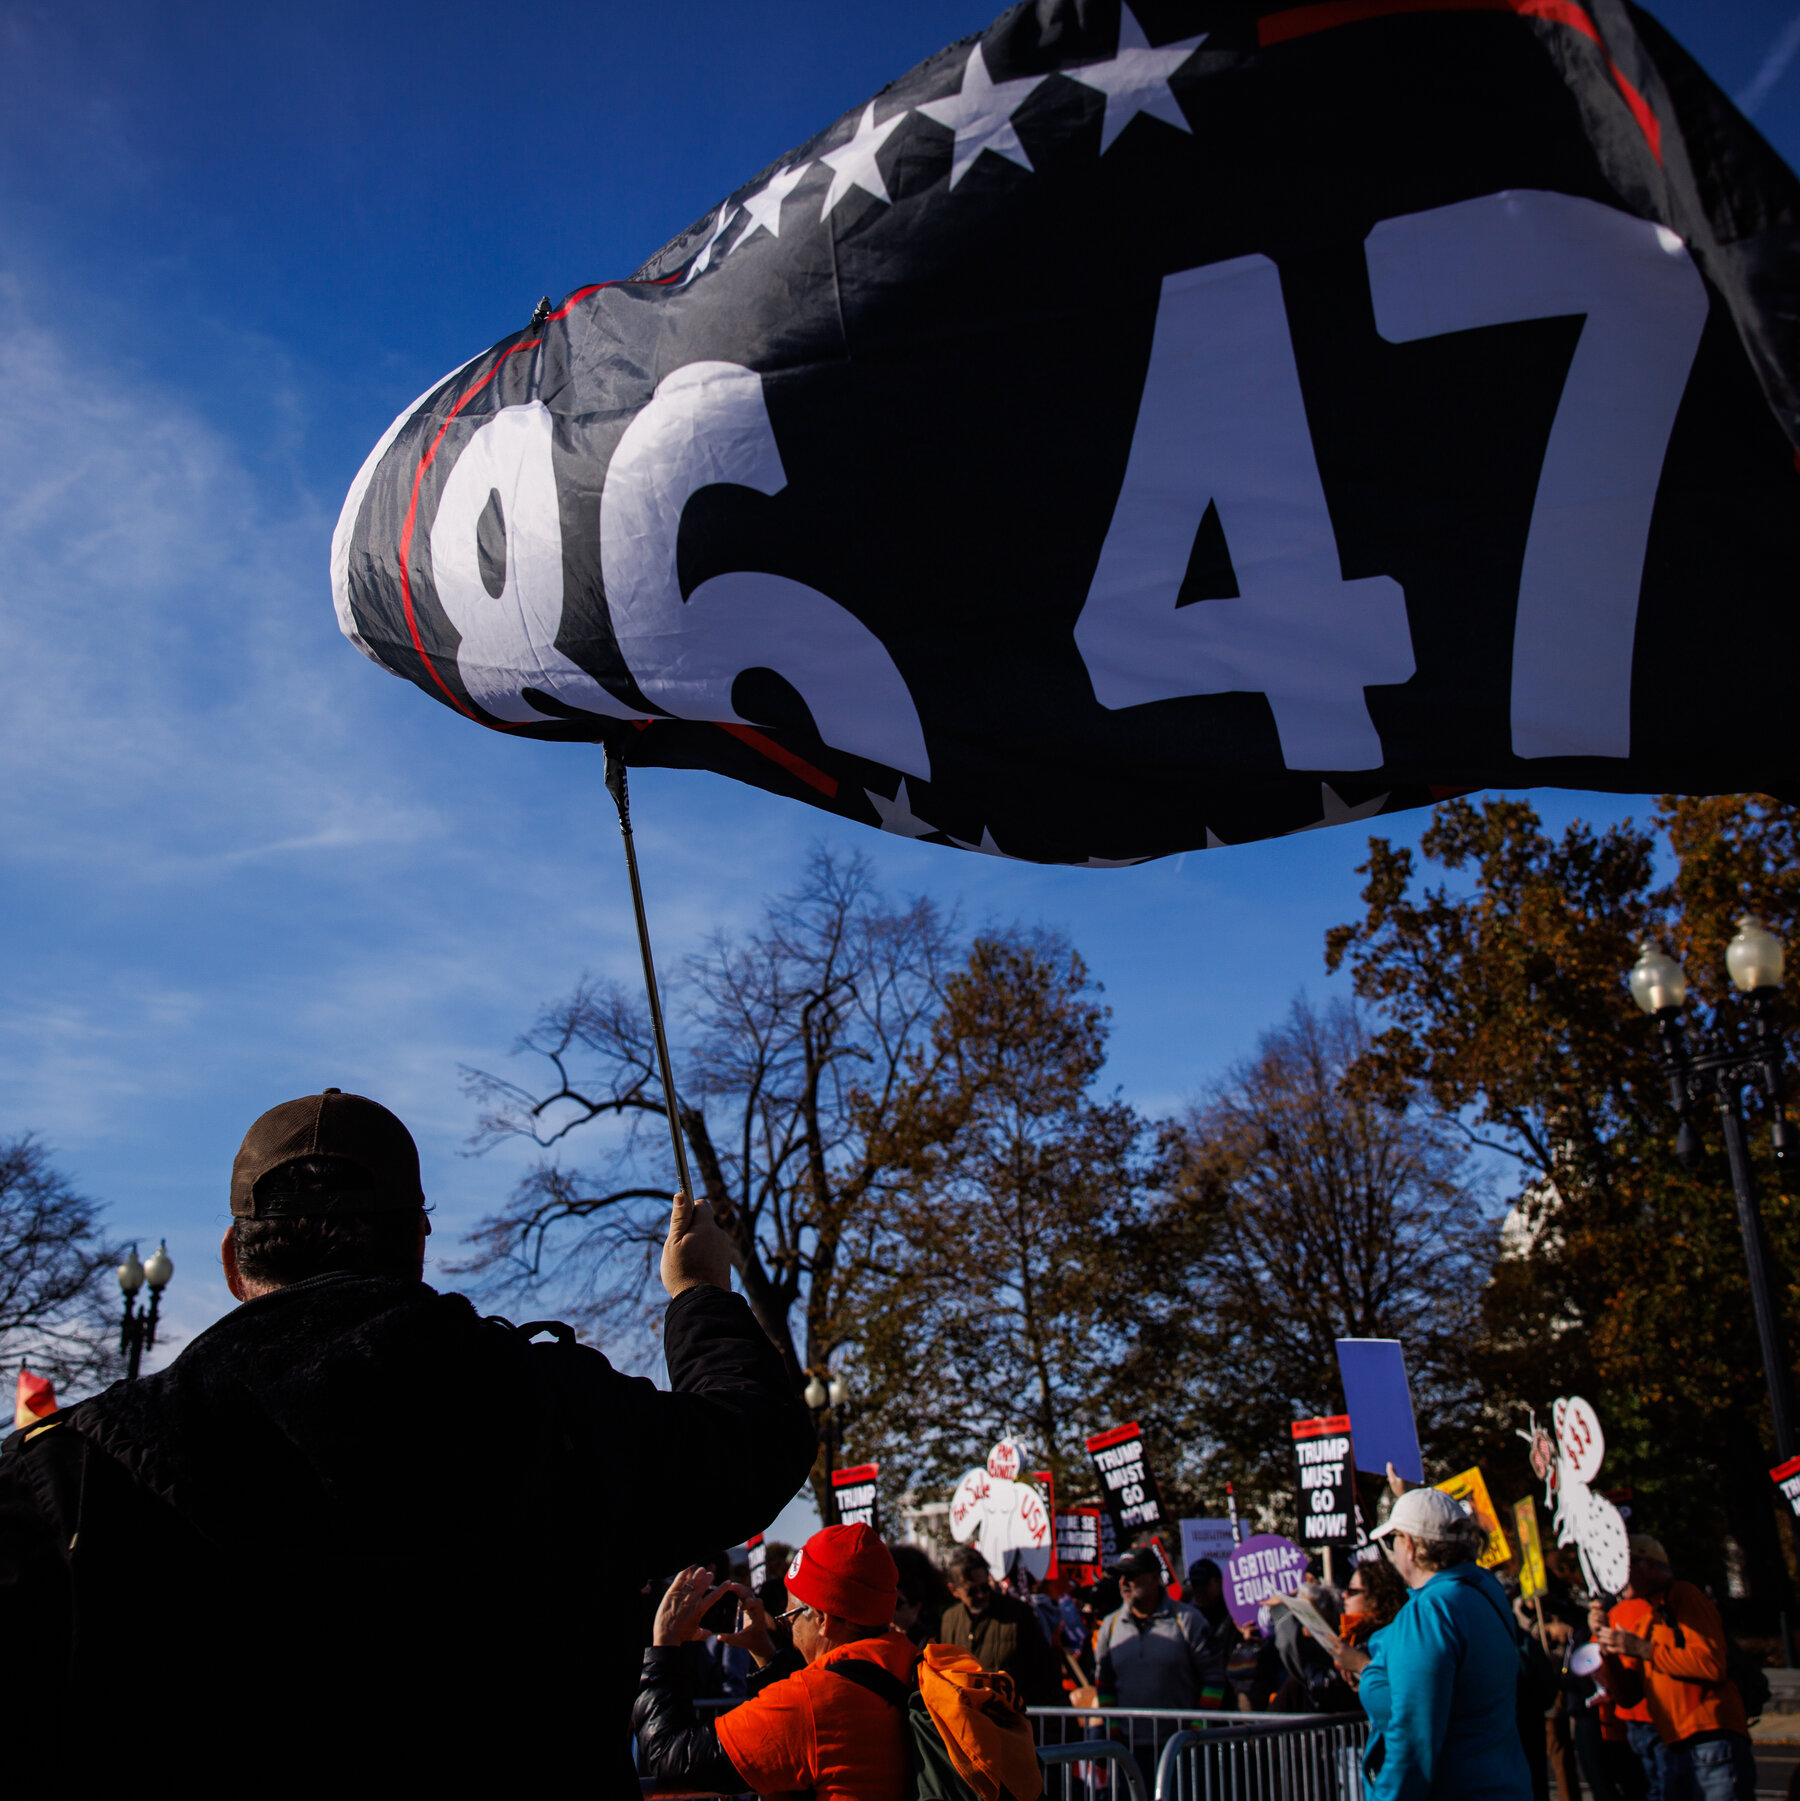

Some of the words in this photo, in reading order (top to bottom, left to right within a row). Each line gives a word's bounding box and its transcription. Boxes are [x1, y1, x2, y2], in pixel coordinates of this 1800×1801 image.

[1073, 188, 1709, 772] 47
[1093, 1440, 1143, 1472] TRUMP
[1295, 1437, 1350, 1465] TRUMP
[1104, 1461, 1146, 1491] MUST
[1301, 1463, 1344, 1489] MUST
[835, 1483, 877, 1511] TRUMP
[1121, 1484, 1145, 1506] GO
[1311, 1489, 1335, 1513] GO
[1021, 1494, 1047, 1548] USA
[1120, 1500, 1160, 1528] NOW!
[1305, 1513, 1347, 1539] NOW!
[1229, 1546, 1301, 1583] LGBTQIA+
[1234, 1568, 1303, 1607] EQUALITY
